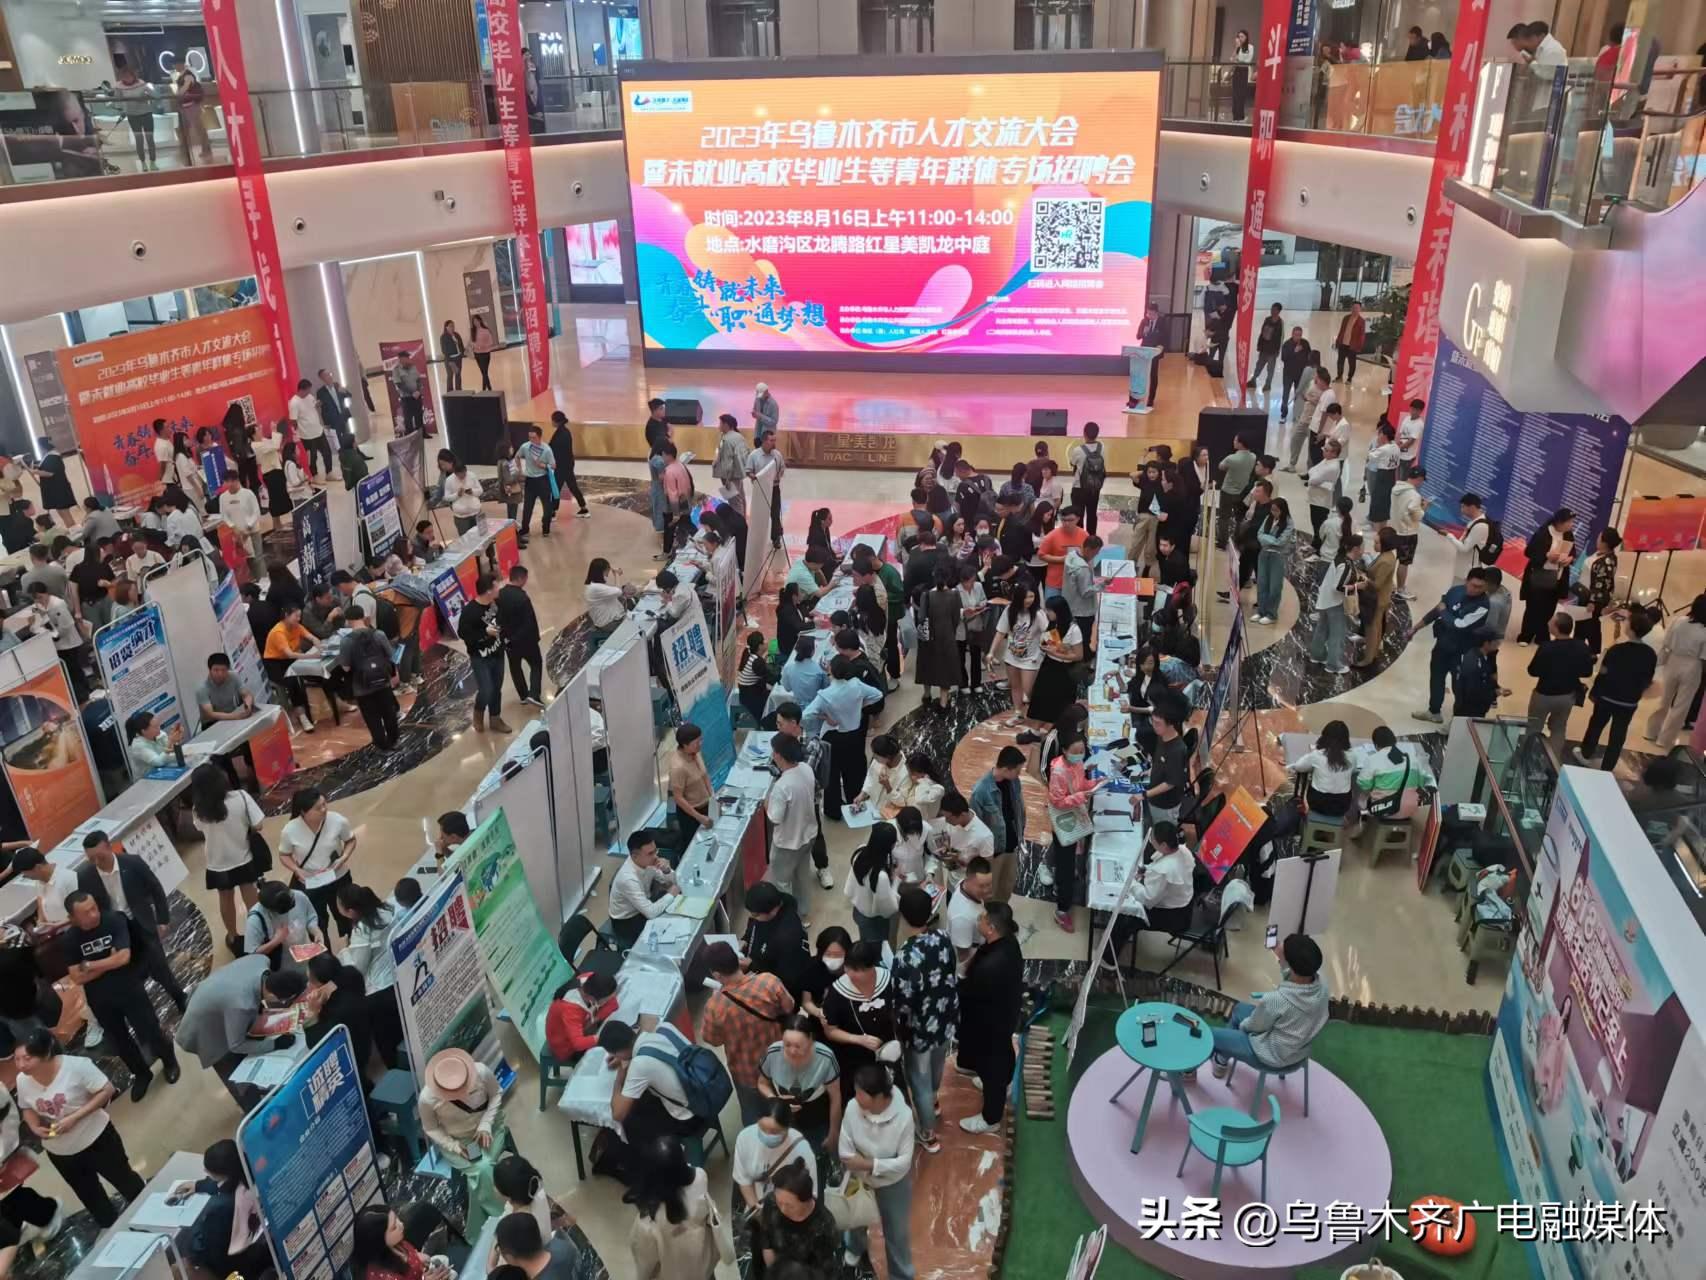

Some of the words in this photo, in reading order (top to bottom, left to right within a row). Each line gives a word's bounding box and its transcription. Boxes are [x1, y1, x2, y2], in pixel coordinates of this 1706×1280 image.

[700, 115, 1080, 149] 2023年乌鲁木齐市人才交流大会
[641, 153, 1137, 188] 暨未就业高校毕业生等青年群体专场招聘会
[703, 207, 1015, 229] 时间:2023年8月16日上午11:00-14:00
[705, 234, 992, 256] 地点:水磨沟区龙腾路红星美凯龙中庭
[671, 623, 708, 668] 招聘
[429, 893, 470, 952] 招聘
